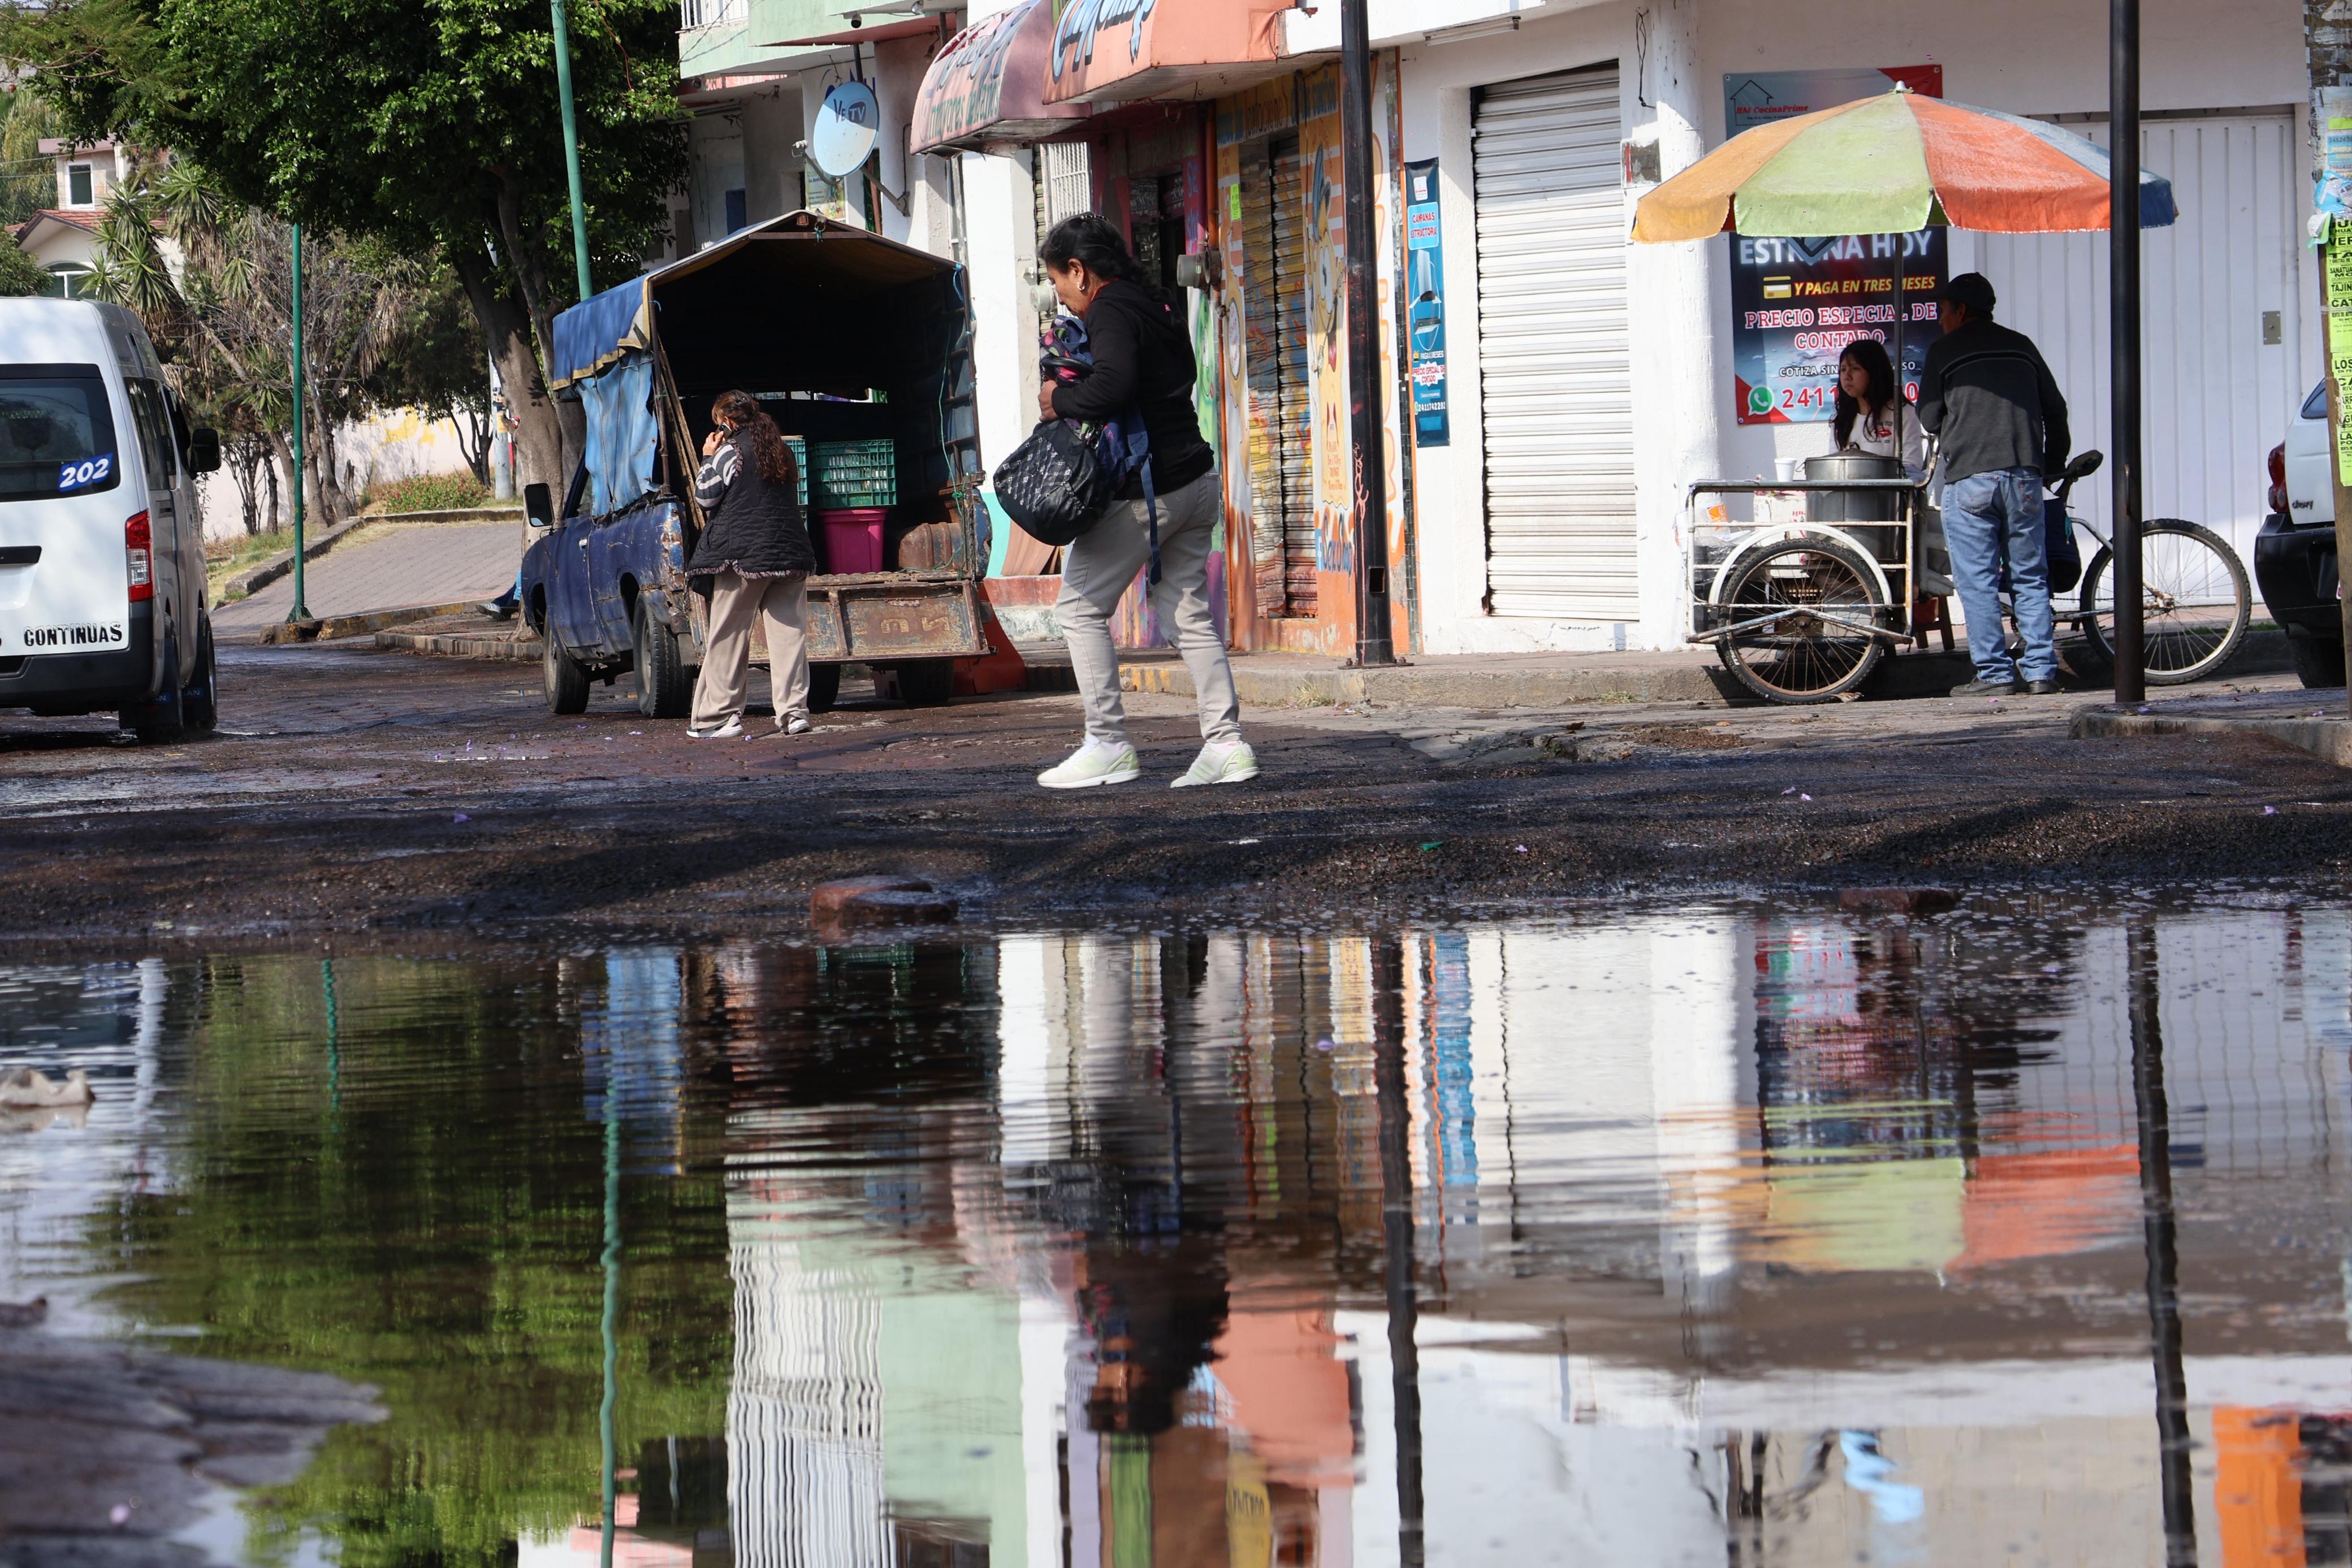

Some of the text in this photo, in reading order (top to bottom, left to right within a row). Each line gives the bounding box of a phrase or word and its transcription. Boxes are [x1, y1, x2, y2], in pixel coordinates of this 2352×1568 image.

[1754, 105, 1809, 114] CocinaPrime
[1795, 282, 1805, 296] Y
[1806, 280, 1839, 295] PAGA
[1843, 280, 1860, 294] EN
[1864, 279, 1893, 293] TRES
[1745, 308, 1814, 329] PRECIO
[1912, 302, 1938, 320] DE
[1779, 364, 1839, 378] COTIZA SIN
[59, 458, 110, 489] 202
[23, 621, 123, 647] CONTINUAS
